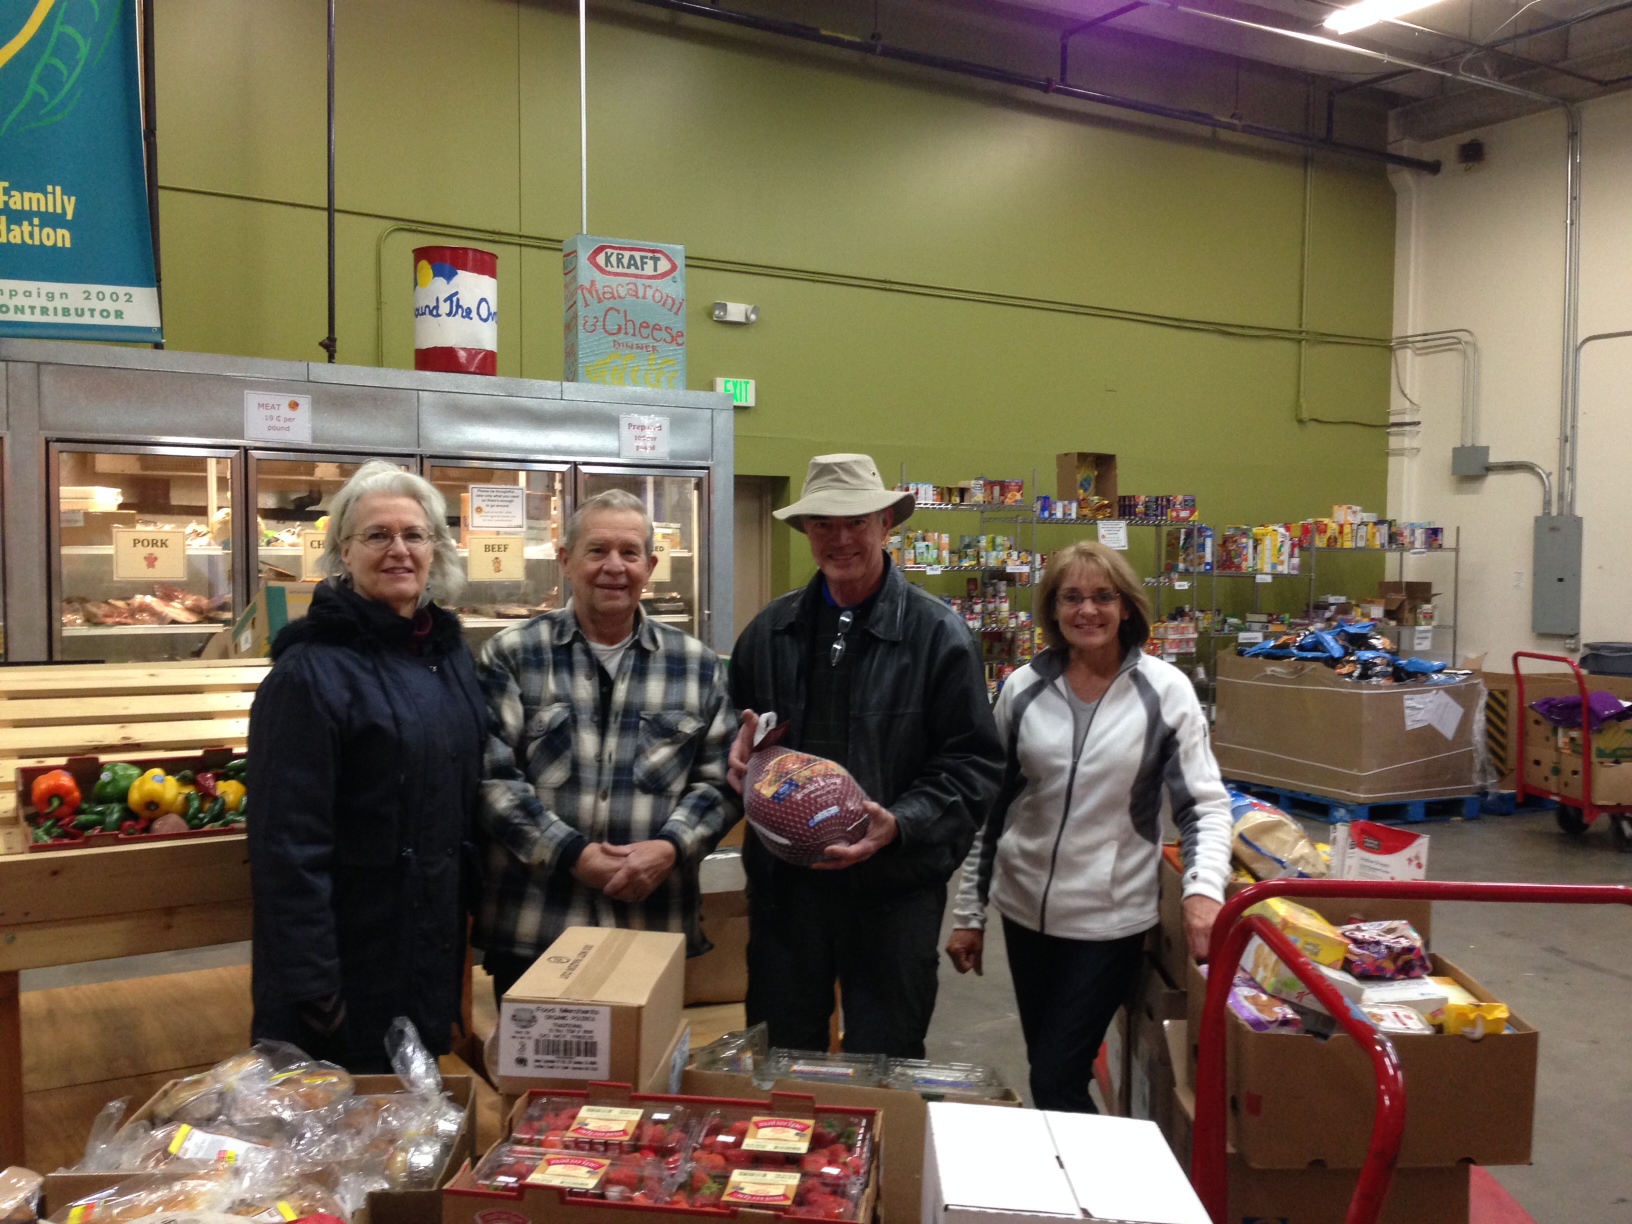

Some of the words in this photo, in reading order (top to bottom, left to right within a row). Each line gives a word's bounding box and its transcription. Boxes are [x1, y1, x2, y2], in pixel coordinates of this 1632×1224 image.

[0, 181, 76, 220] Family
[604, 250, 661, 272] KRAFT
[0, 287, 69, 302] paign
[82, 289, 133, 303] 2002
[443, 290, 473, 320] The
[578, 279, 685, 316] Macaroni
[582, 315, 599, 333] &
[602, 306, 685, 346] Cheese
[612, 339, 659, 353] DINNER
[723, 379, 750, 403] EXIT
[257, 402, 282, 411] MEAT
[132, 537, 169, 548] PORK
[483, 544, 509, 553] BEEF
